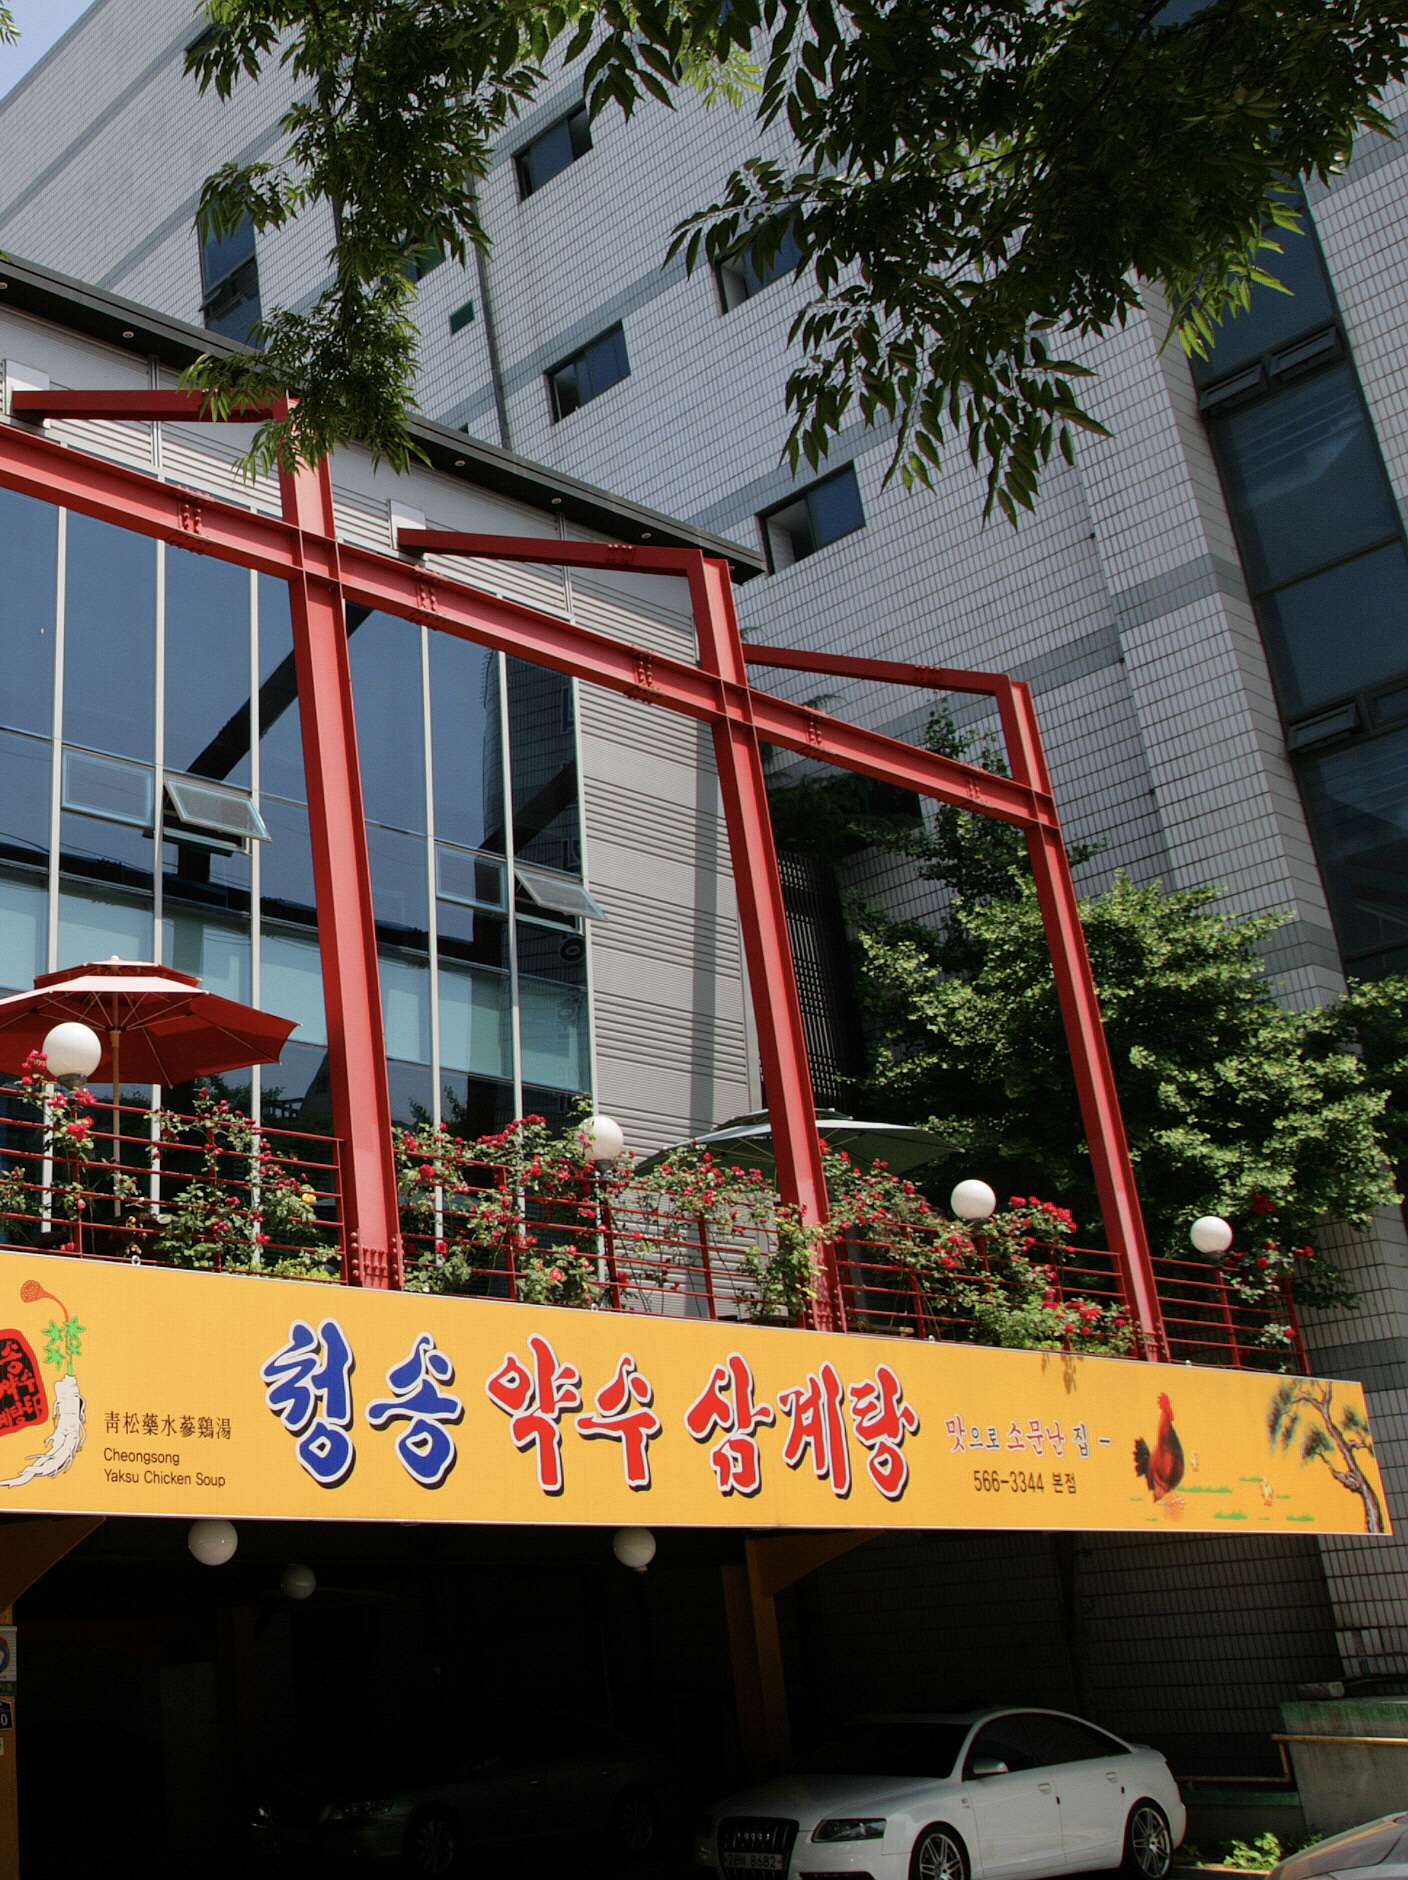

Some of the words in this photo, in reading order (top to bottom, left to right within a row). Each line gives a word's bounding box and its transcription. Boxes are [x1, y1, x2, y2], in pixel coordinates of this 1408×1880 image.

[260, 1317, 466, 1488] 청송
[485, 1332, 663, 1495] 약수
[684, 1351, 921, 1501] 삼계탕
[944, 1414, 1001, 1453] 맛으로
[1007, 1419, 1065, 1457] 소문난
[1072, 1422, 1090, 1458] 집
[103, 1447, 180, 1466] Cheongsong
[103, 1468, 140, 1484] Yaksu
[143, 1470, 192, 1485] Chicken
[195, 1472, 226, 1488] Soup
[973, 1469, 1045, 1493] 566-3344
[1051, 1471, 1077, 1495] 본점
